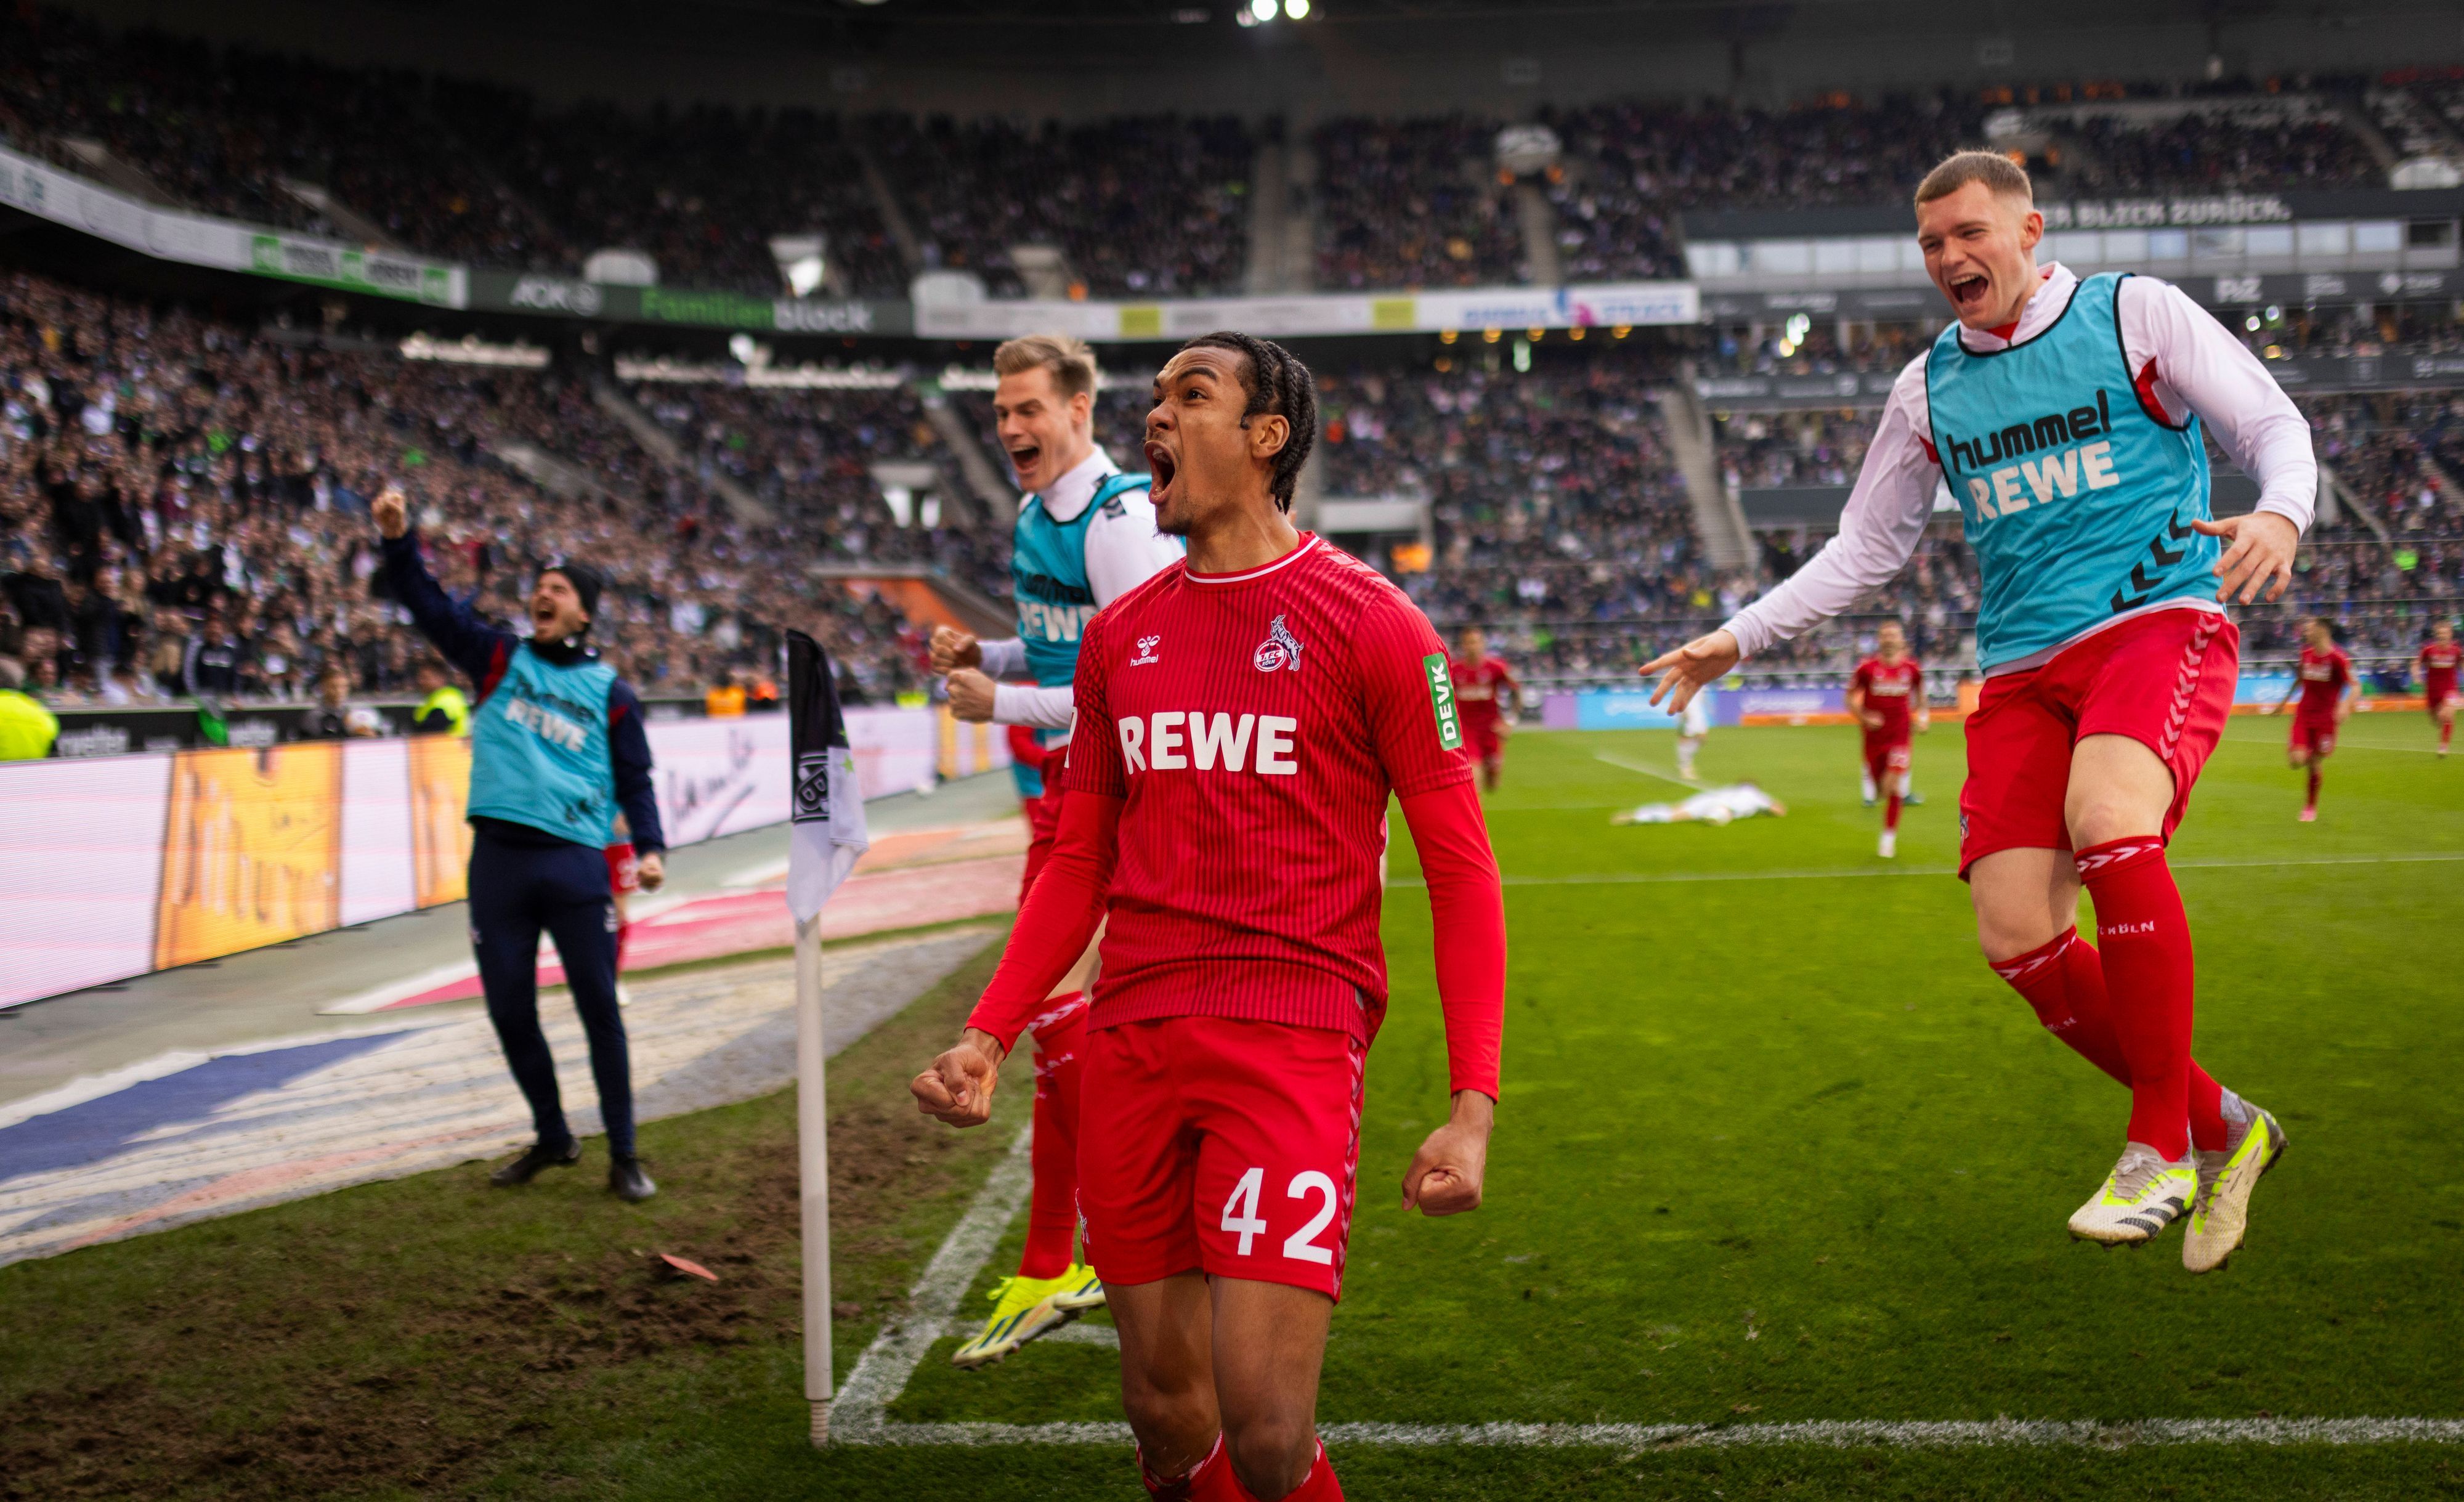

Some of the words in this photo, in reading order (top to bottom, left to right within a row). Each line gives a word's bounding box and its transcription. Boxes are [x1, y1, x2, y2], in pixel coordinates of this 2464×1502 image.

[1946, 389, 2112, 475] hummel
[1968, 440, 2120, 523] REWE
[1130, 654, 1159, 667] hummel
[505, 698, 588, 753] REWE
[1431, 662, 1457, 741] DEVK
[1118, 711, 1297, 775] REWE
[1221, 1167, 1337, 1266] 42
